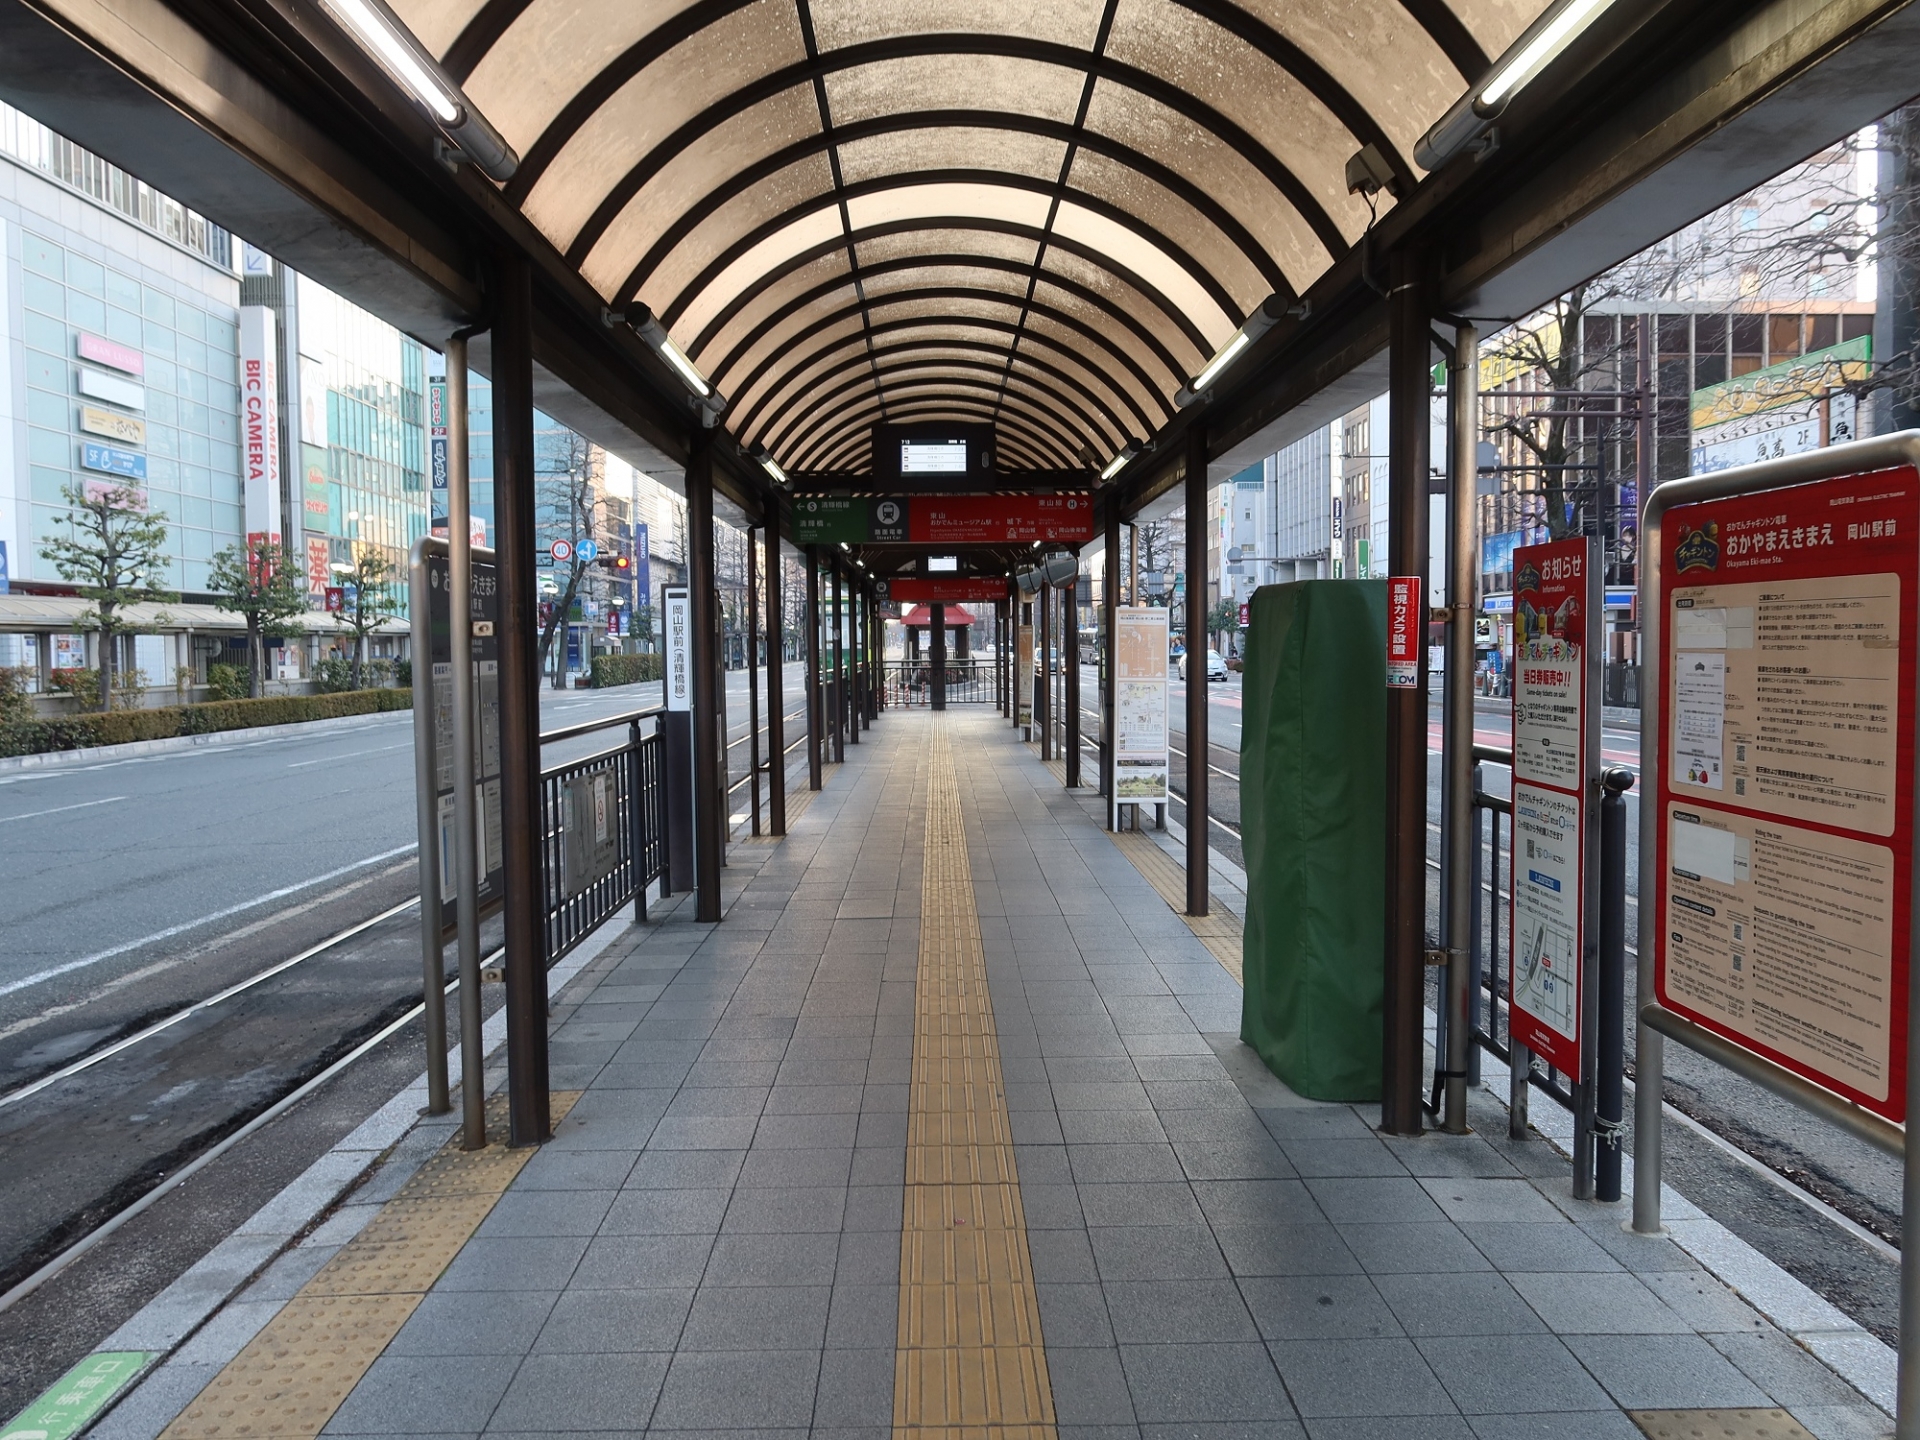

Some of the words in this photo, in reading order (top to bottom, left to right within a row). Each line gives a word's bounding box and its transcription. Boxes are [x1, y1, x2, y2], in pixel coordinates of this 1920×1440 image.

[246, 359, 261, 391] BIC
[247, 397, 264, 480] CAMERA
[269, 398, 277, 480] CAMERA
[433, 427, 444, 436] 2F
[1797, 429, 1809, 446] 2F
[1693, 450, 1704, 466] 24
[1726, 523, 1834, 556] おかやまえきまえ
[1847, 518, 1897, 540] 岡山駅前
[556, 546, 568, 555] 40
[309, 541, 329, 593] 薬
[1541, 555, 1582, 581] お知らせ
[1726, 559, 1750, 568] Okayama
[1750, 557, 1772, 566] Eki-mae
[1542, 584, 1566, 593] Information
[1392, 583, 1408, 656] 監視カメラ設置
[1523, 669, 1572, 687] 当日券販売中!!
